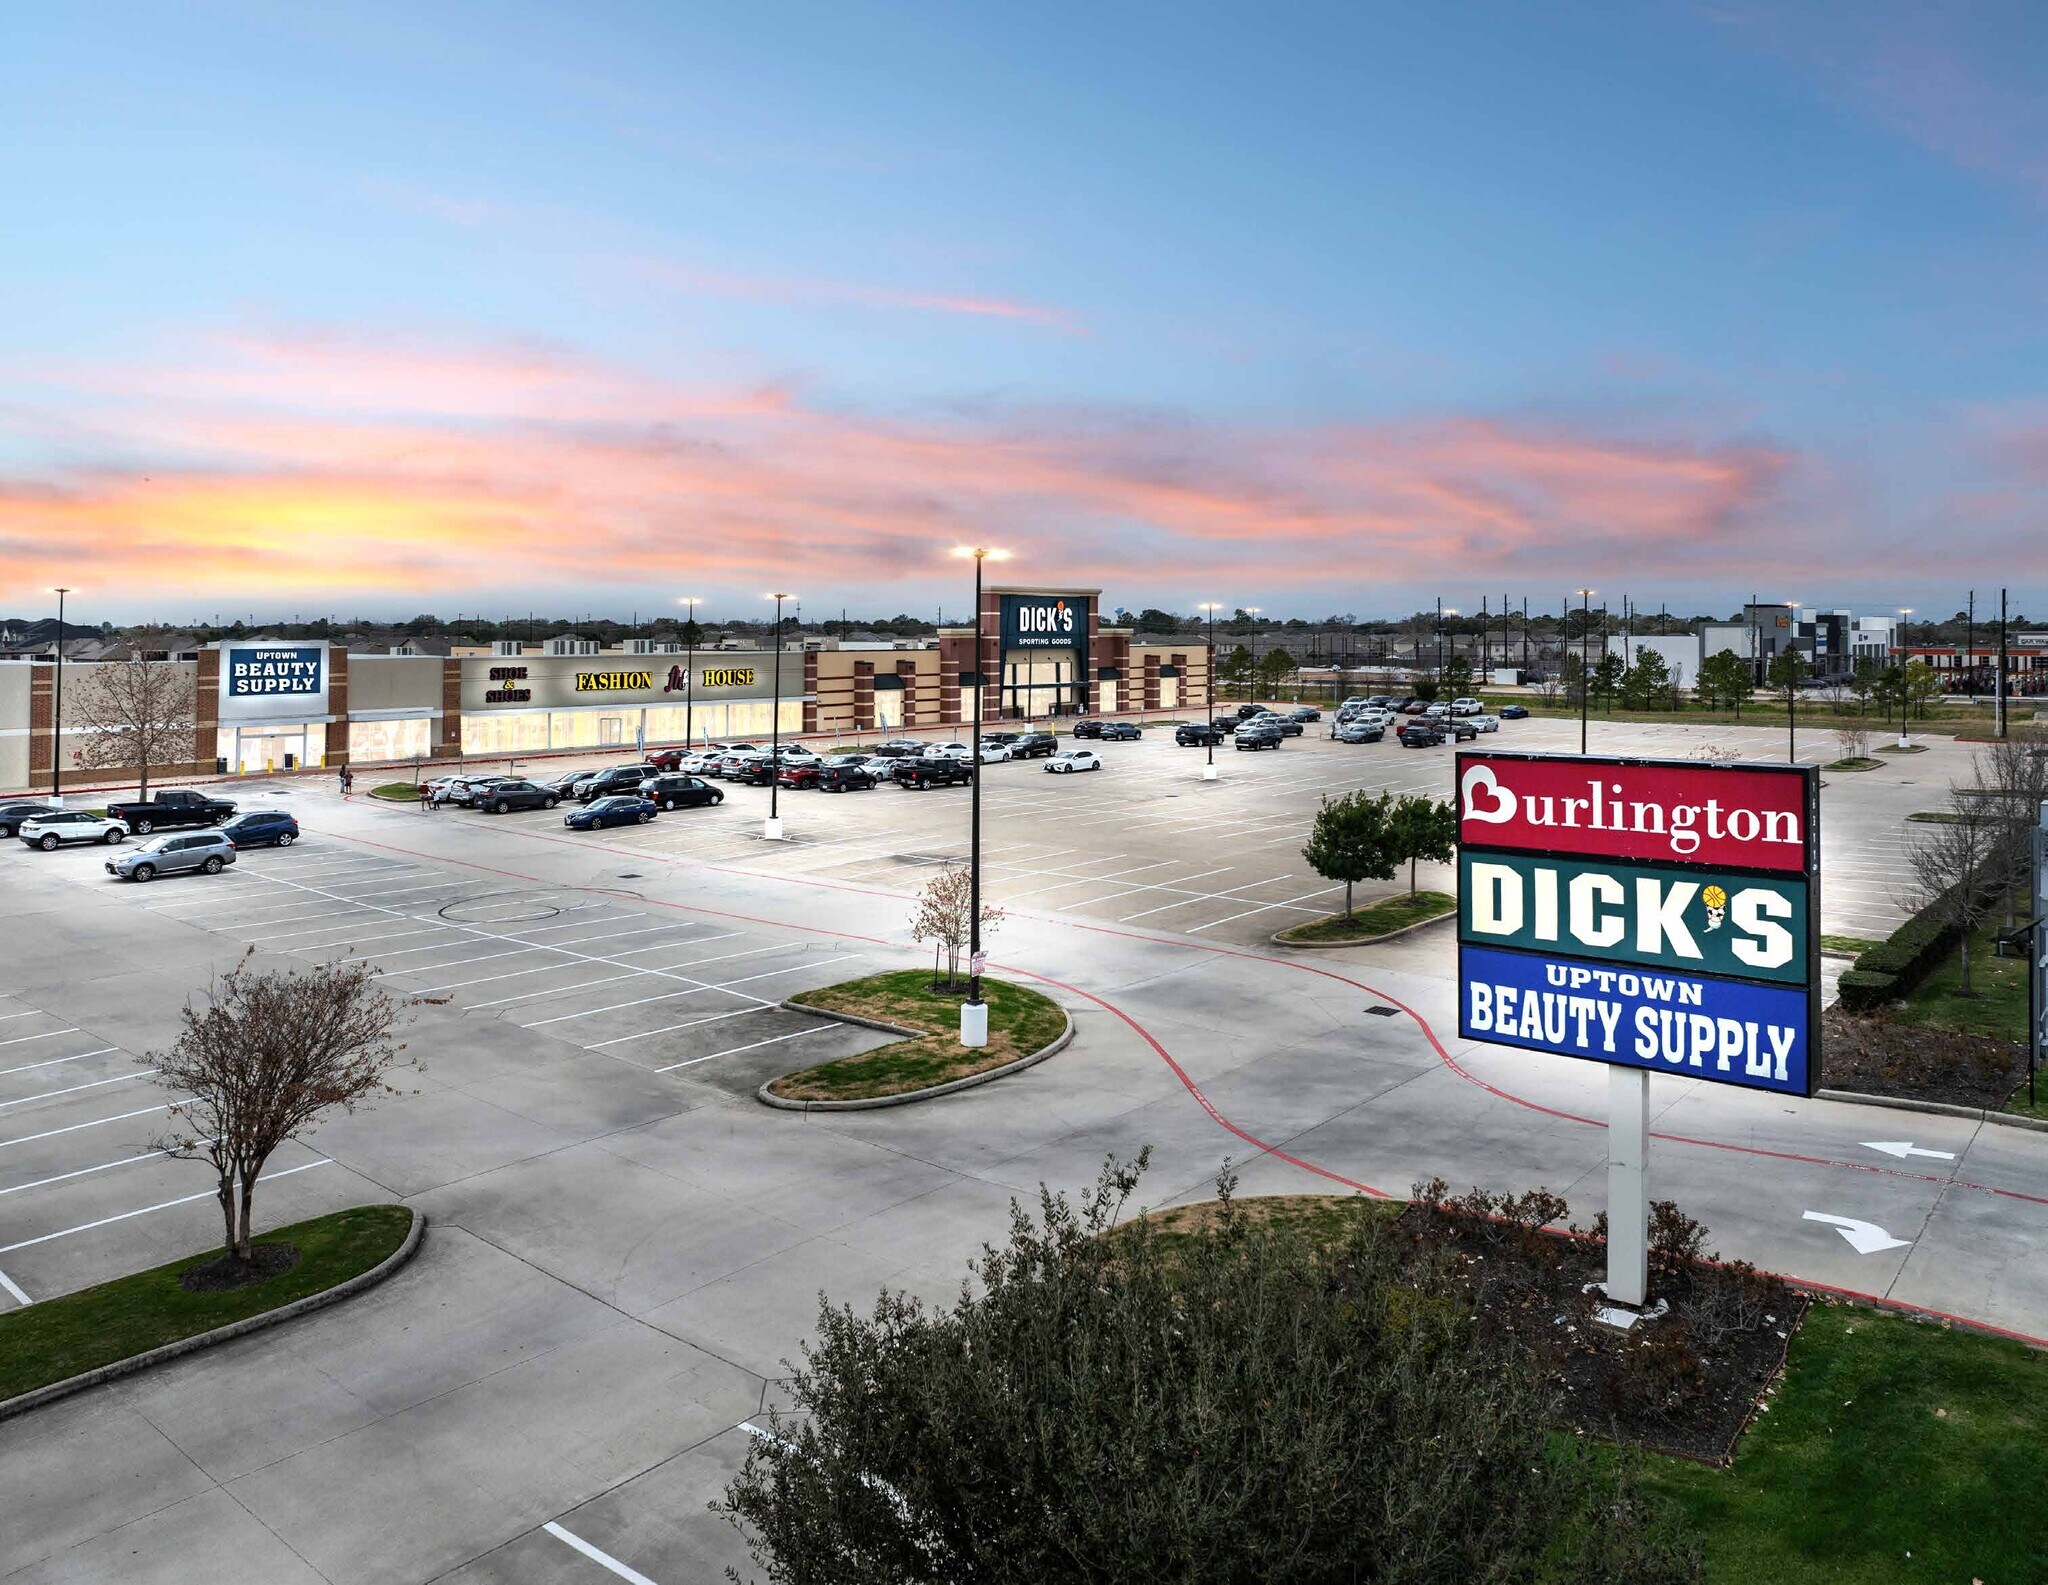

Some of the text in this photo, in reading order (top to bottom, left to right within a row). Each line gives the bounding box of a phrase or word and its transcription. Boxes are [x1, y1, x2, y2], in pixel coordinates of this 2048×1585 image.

[1019, 601, 1072, 631] DICK'S
[234, 662, 317, 676] BEAUTY
[576, 672, 653, 691] FASHION
[703, 668, 756, 688] HOUSE
[236, 678, 314, 692] SUPPLY
[485, 689, 531, 703] SHOES
[503, 680, 515, 690] &
[1462, 764, 1803, 854] Burlington
[1471, 862, 1793, 969] DICK'S
[1545, 964, 1703, 1006] UPTOWN
[1470, 981, 1795, 1081] BEAUTY SUPPLY
